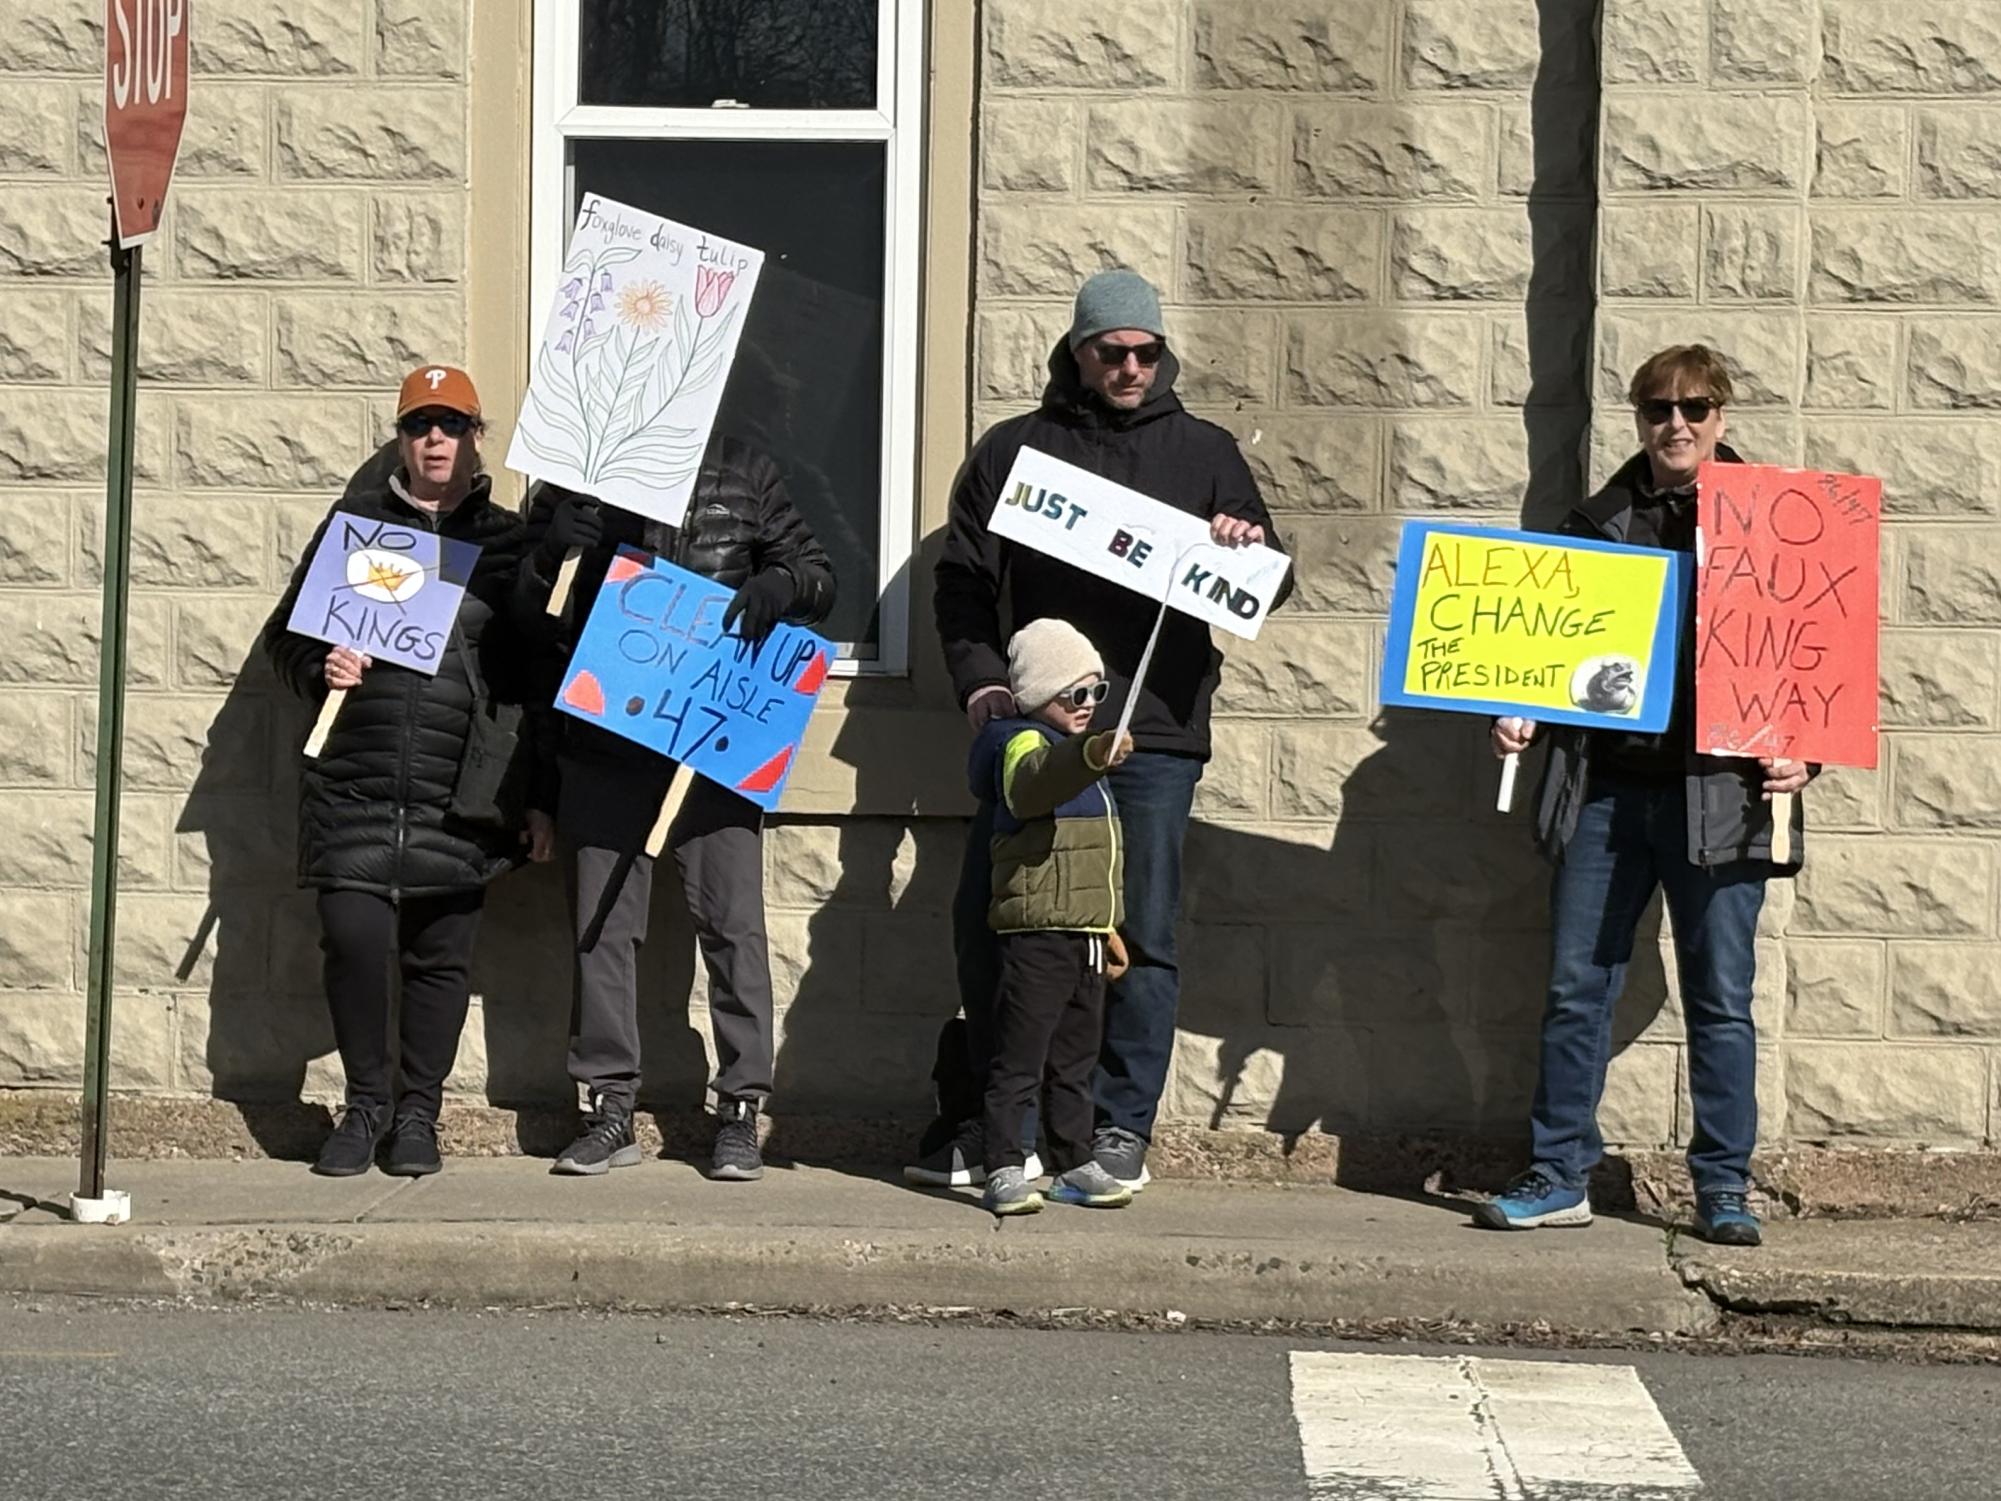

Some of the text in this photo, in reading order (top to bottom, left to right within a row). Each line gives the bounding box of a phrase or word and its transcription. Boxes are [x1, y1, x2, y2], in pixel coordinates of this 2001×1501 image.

[113, 0, 182, 110] STOP
[580, 199, 749, 276] foxglove daisy tulip
[424, 369, 447, 390] P
[344, 520, 417, 552] NO
[1713, 484, 1824, 546] NO
[1004, 481, 1261, 620] JUST BE KIND
[1421, 542, 1580, 600] ALEXA,
[1701, 546, 1859, 619] FAUX
[322, 594, 445, 661] KINGS
[1430, 594, 1615, 637] CHANGE
[1699, 605, 1829, 672] KING
[618, 629, 785, 725] ON AISLE
[770, 631, 817, 687] UP
[1417, 637, 1464, 659] THE
[1420, 660, 1566, 692] PRESIDENT
[1730, 677, 1845, 728] WAY
